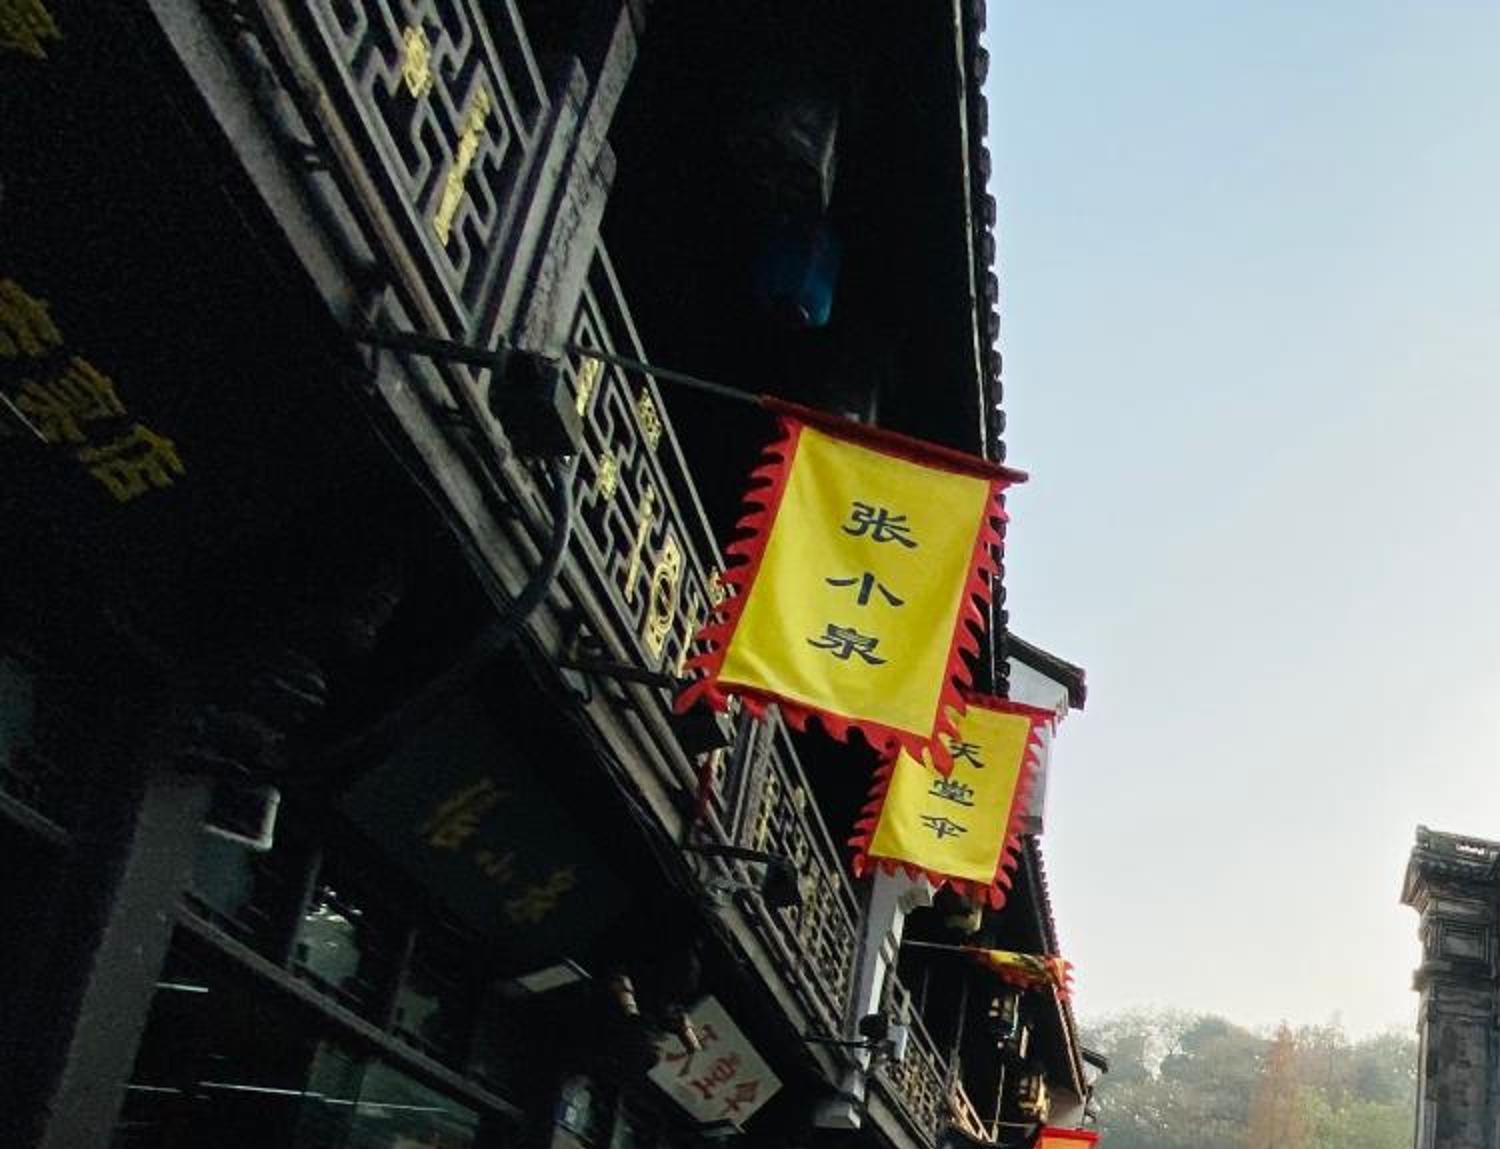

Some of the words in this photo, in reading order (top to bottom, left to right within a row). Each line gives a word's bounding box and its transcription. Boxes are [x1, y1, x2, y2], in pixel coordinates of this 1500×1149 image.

[806, 501, 918, 665] 张小泉
[920, 739, 985, 839] 天堂伞
